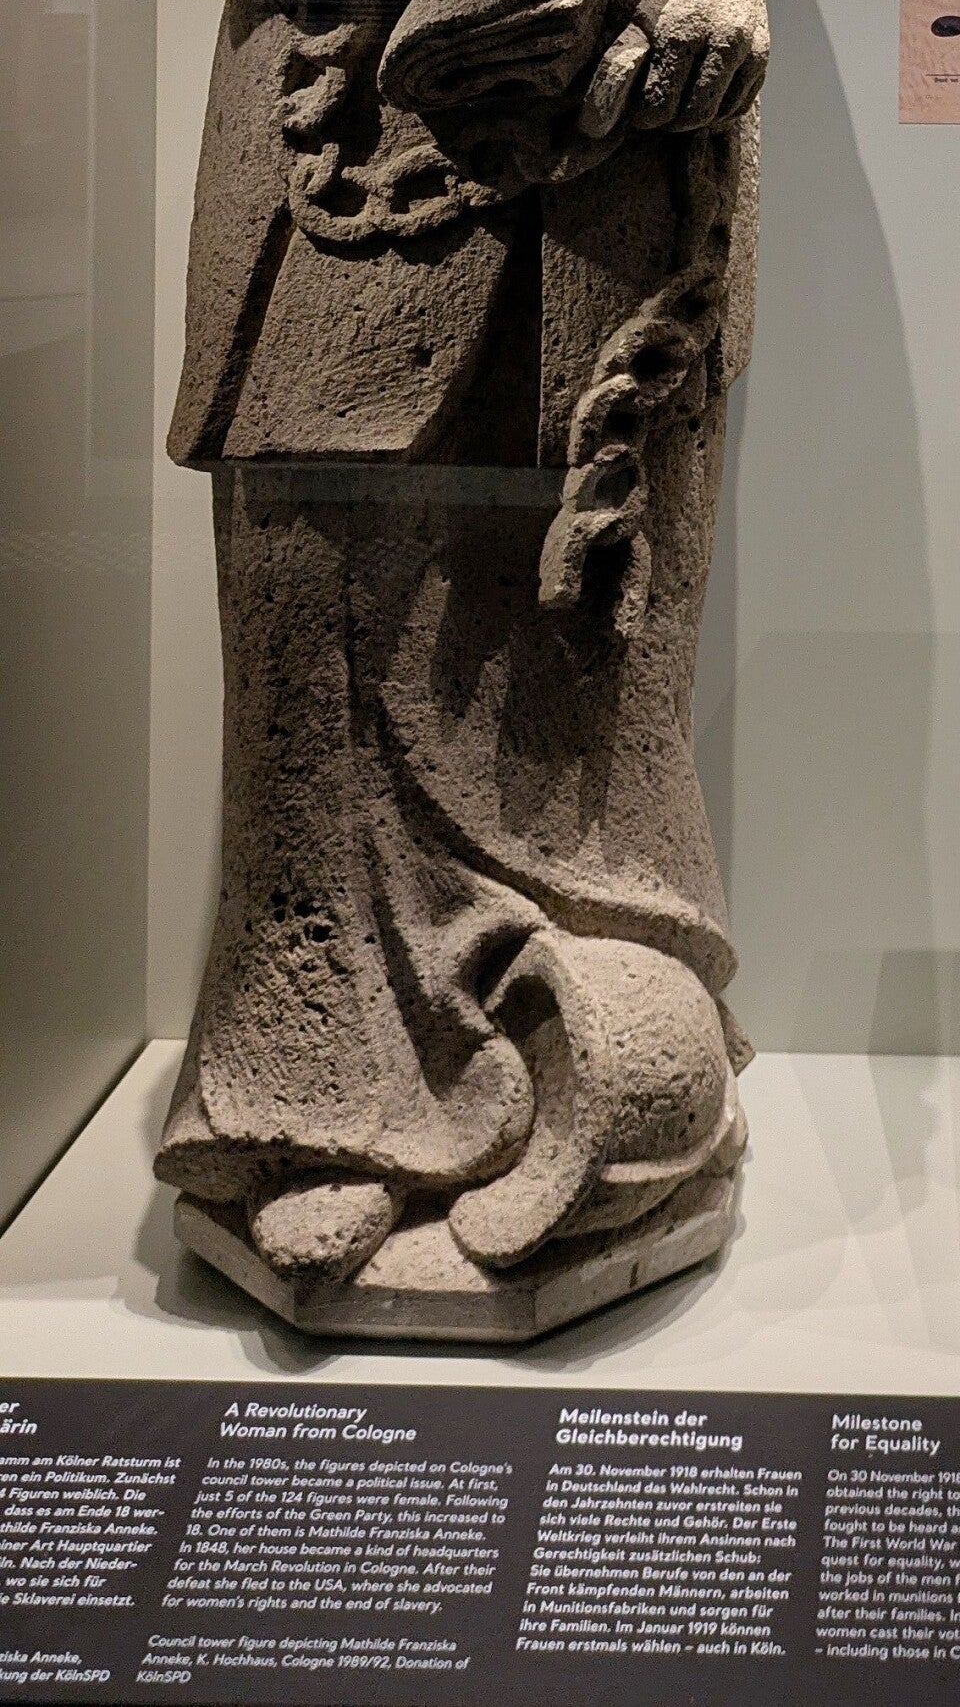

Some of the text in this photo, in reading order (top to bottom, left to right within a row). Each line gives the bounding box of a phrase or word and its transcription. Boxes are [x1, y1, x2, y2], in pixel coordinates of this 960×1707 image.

[224, 1402, 366, 1422] A Revolutionary
[559, 1408, 707, 1425] Meilenstein der
[0, 1418, 36, 1433] ärin
[832, 1414, 921, 1431] Milestone
[220, 1422, 416, 1443] Woman from Cologne
[556, 1428, 742, 1451] Gleichberechtigung
[831, 1433, 940, 1455] for Equality
[32, 1457, 52, 1465] am
[55, 1455, 99, 1466] Kölner
[101, 1455, 161, 1467] Ratsturm
[164, 1457, 180, 1467] ist
[207, 1457, 219, 1467] In
[223, 1457, 245, 1468] the
[249, 1458, 289, 1470] 1980s,
[294, 1458, 315, 1469] the
[319, 1459, 364, 1473] figures
[368, 1460, 426, 1473] depicted
[429, 1464, 445, 1472] on
[20, 1471, 41, 1481] ein
[44, 1471, 109, 1482] Politikum.
[114, 1472, 175, 1484] Zunächst
[549, 1463, 801, 1480] Am 30. November 1918 erhalten Frauen
[827, 1469, 847, 1481] On
[850, 1469, 867, 1482] 30
[870, 1470, 934, 1483] November
[202, 1474, 497, 1490] council tower became a political issue. At first,
[546, 1480, 798, 1496] in Deutschland das Wahlrecht. Schon in
[148, 1634, 456, 1652] Council tower figure depicting Mathilde Franziska
[515, 1636, 564, 1650] Frauen
[568, 1638, 627, 1651] erstmals
[631, 1639, 680, 1652] wählen
[696, 1640, 729, 1653] auch
[733, 1641, 746, 1653] in
[750, 1641, 785, 1654] Köln.
[141, 1653, 470, 1670] Anneke, K. Hochhaus, Cologne 1989/92, Donation of
[136, 1670, 191, 1683] KölnSPD
